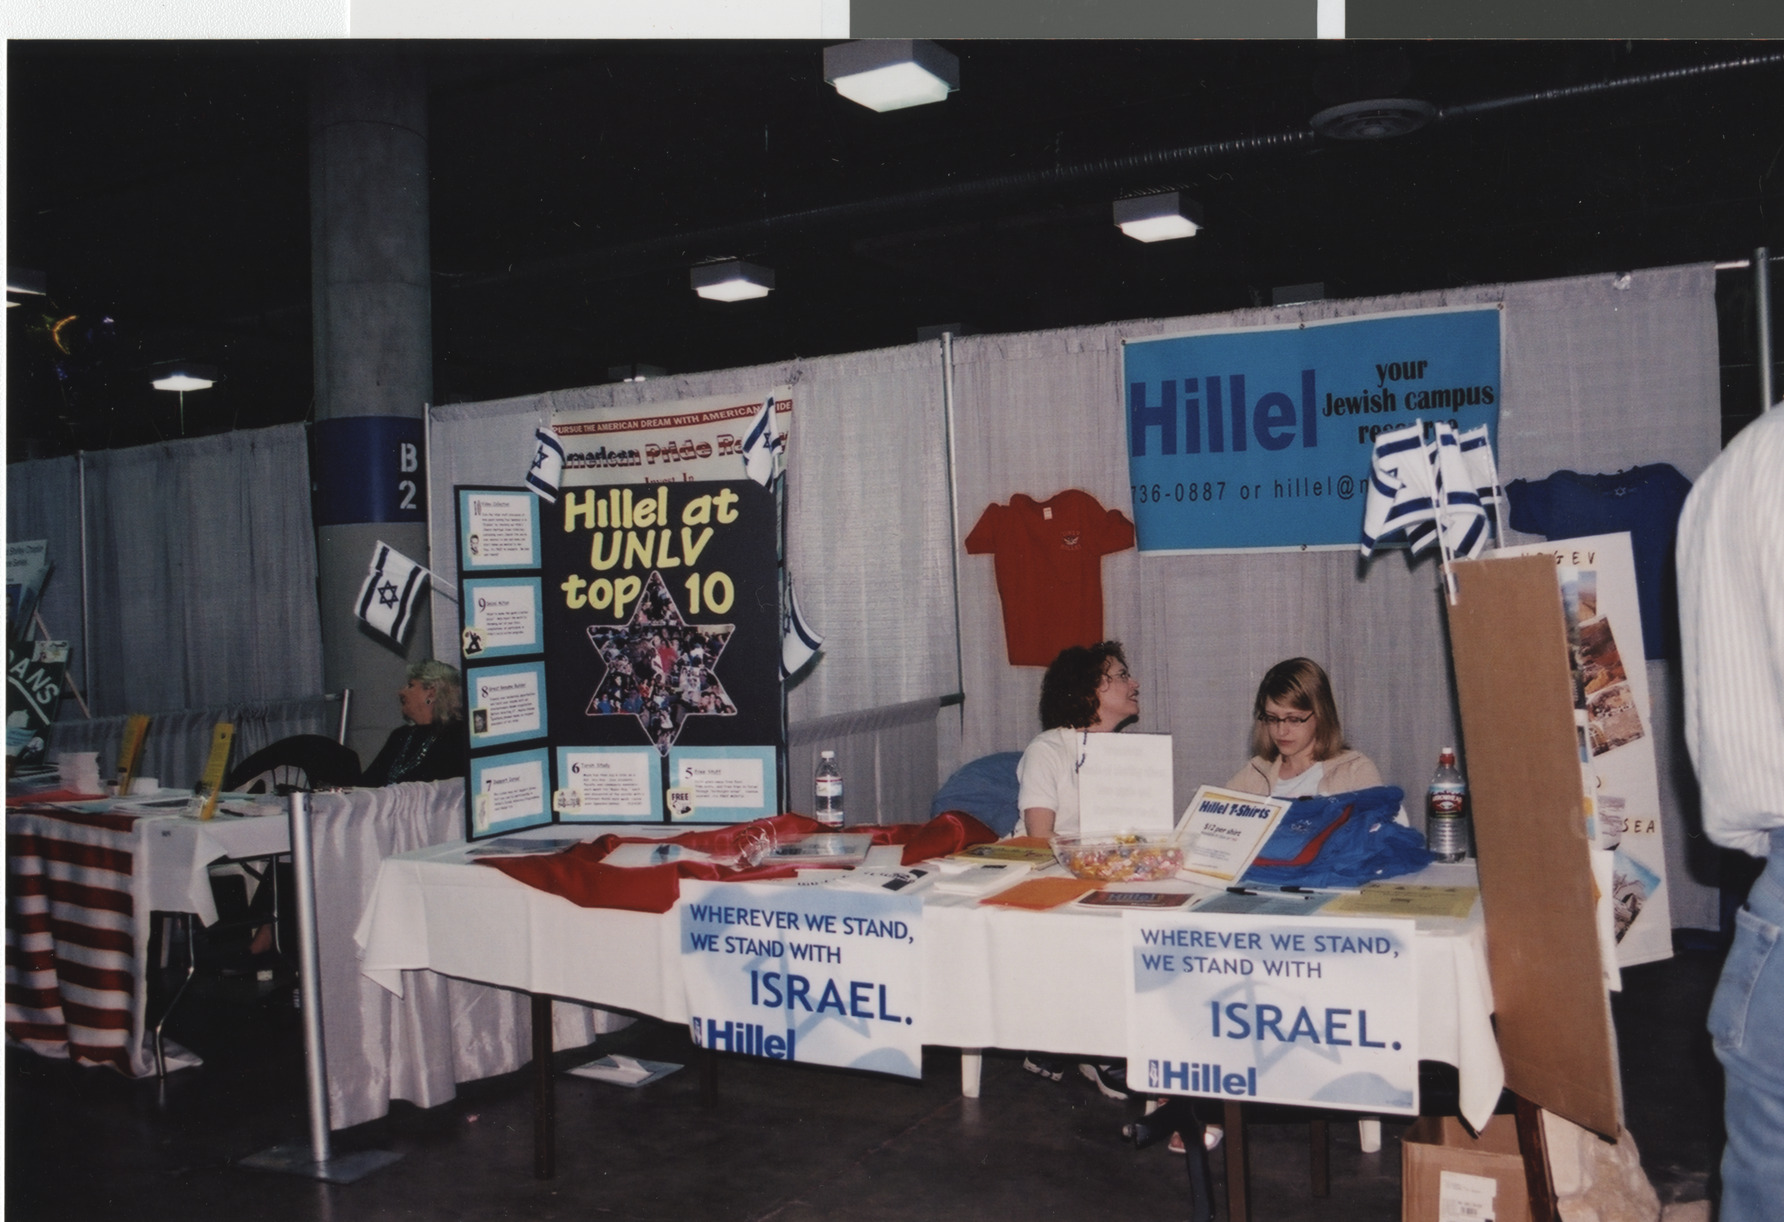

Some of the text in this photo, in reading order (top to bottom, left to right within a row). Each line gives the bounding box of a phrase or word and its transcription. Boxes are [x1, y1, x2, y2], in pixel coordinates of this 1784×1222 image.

[1375, 359, 1428, 388] your
[1130, 369, 1318, 457] Hillel
[1322, 384, 1494, 417] Jewish campus
[552, 425, 583, 434] PURSUE
[597, 420, 639, 431] AMERICAN
[640, 417, 671, 428] DREAM
[672, 414, 699, 425] WITH
[702, 405, 761, 421] AMERICAN
[401, 443, 418, 472] B
[561, 446, 642, 469] merican
[644, 439, 713, 465] Pride
[398, 480, 416, 509] 2
[1240, 483, 1261, 499] or
[564, 486, 739, 532] Hillel at
[591, 527, 714, 570] UNLV
[478, 598, 486, 613] 9
[561, 571, 735, 618] top 10
[481, 686, 489, 698] 8
[572, 762, 580, 774] 6
[685, 767, 693, 779] 5
[486, 779, 492, 792] 7
[671, 793, 689, 801] FREE
[1199, 800, 1271, 819] Hillel T-Shirts
[1203, 823, 1217, 831] $12
[1227, 827, 1242, 837] shirt
[1621, 817, 1655, 833] SEA
[690, 903, 914, 944] WHEREVER WE STAND,
[690, 932, 842, 964] WE STAND WITH
[1140, 928, 1400, 958] WHEREVER WE STAND,
[1141, 953, 1322, 978] WE STAND WITH
[751, 970, 913, 1025] ISRAEL.
[707, 1018, 796, 1061] Hillel
[1210, 1000, 1402, 1051] ISRAEL.
[1162, 1060, 1257, 1096] Hillel
